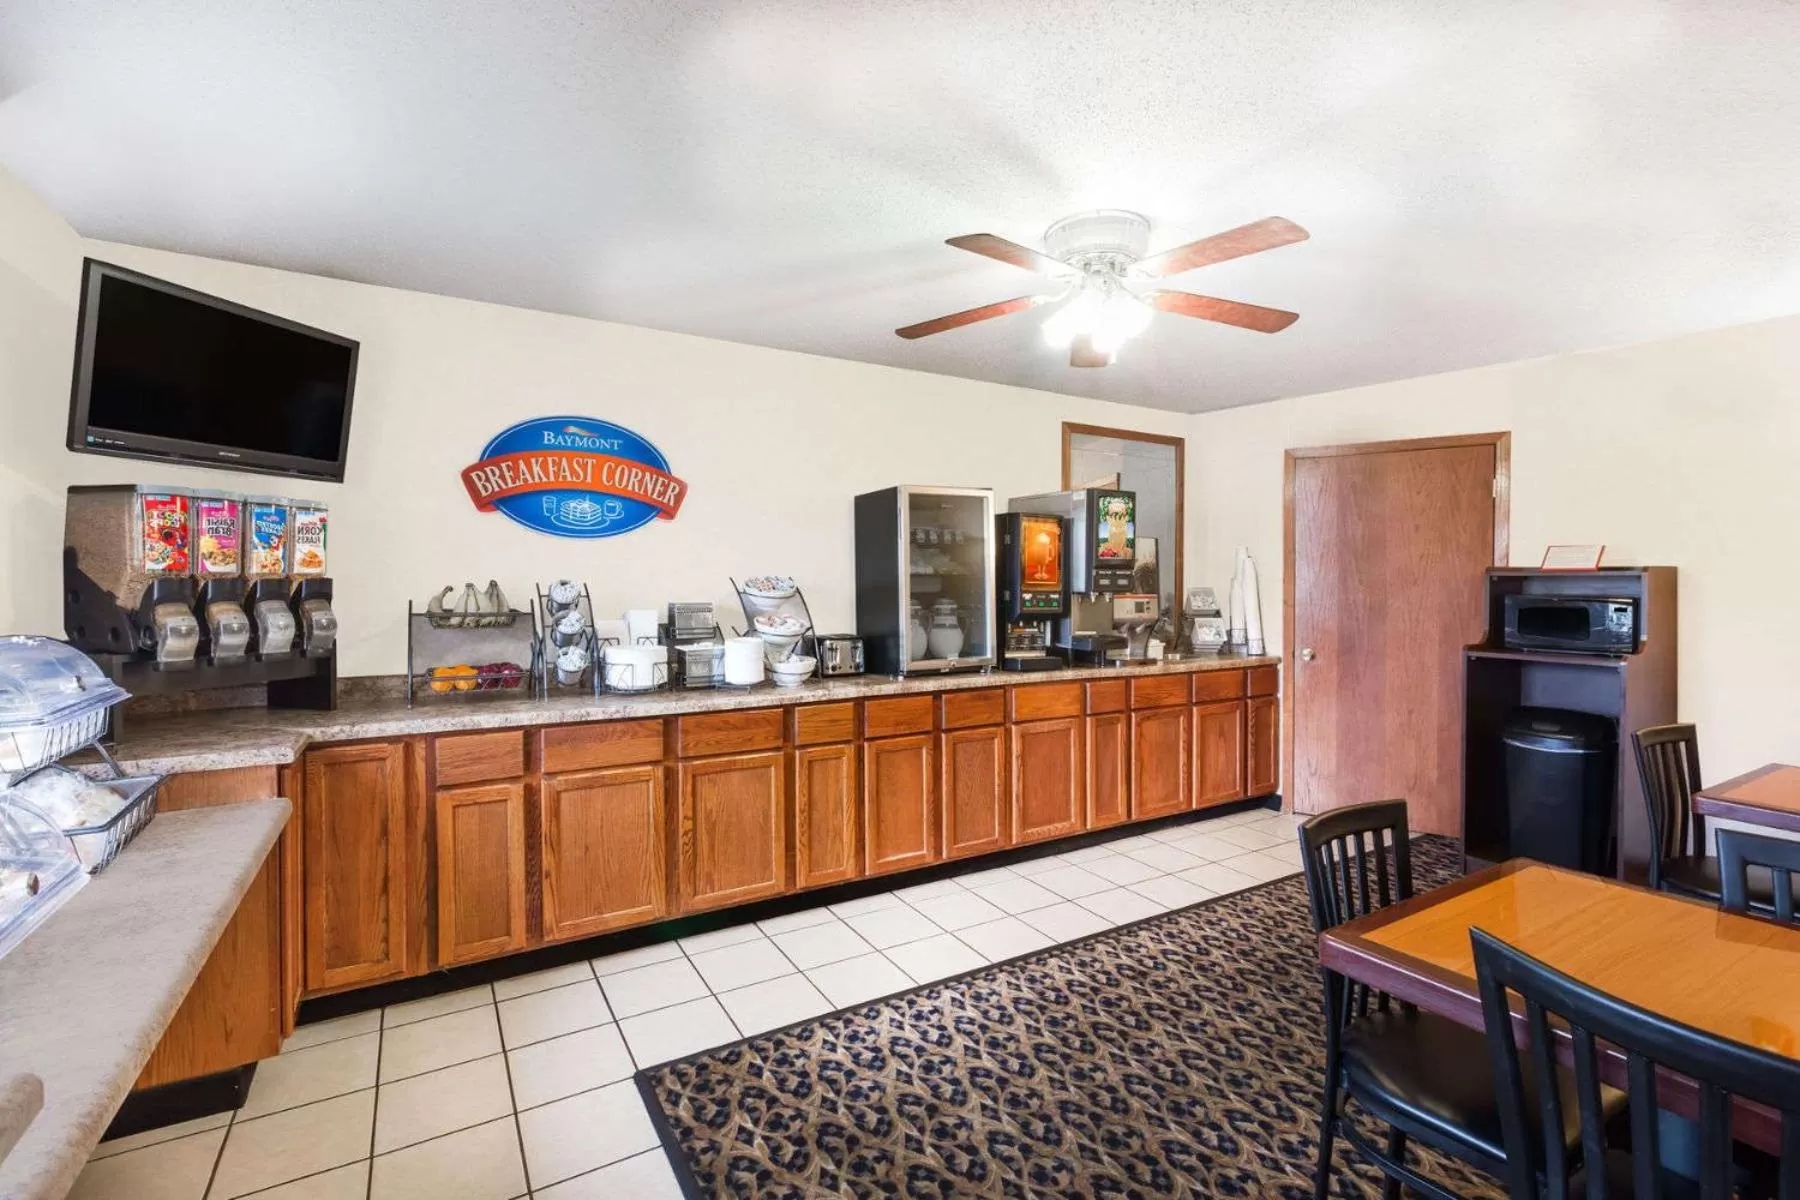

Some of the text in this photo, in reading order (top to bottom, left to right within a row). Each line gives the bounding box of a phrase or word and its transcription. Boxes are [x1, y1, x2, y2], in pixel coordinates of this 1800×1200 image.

[542, 431, 621, 450] BAYMONT
[470, 456, 681, 507] BREAKFAST CORNER
